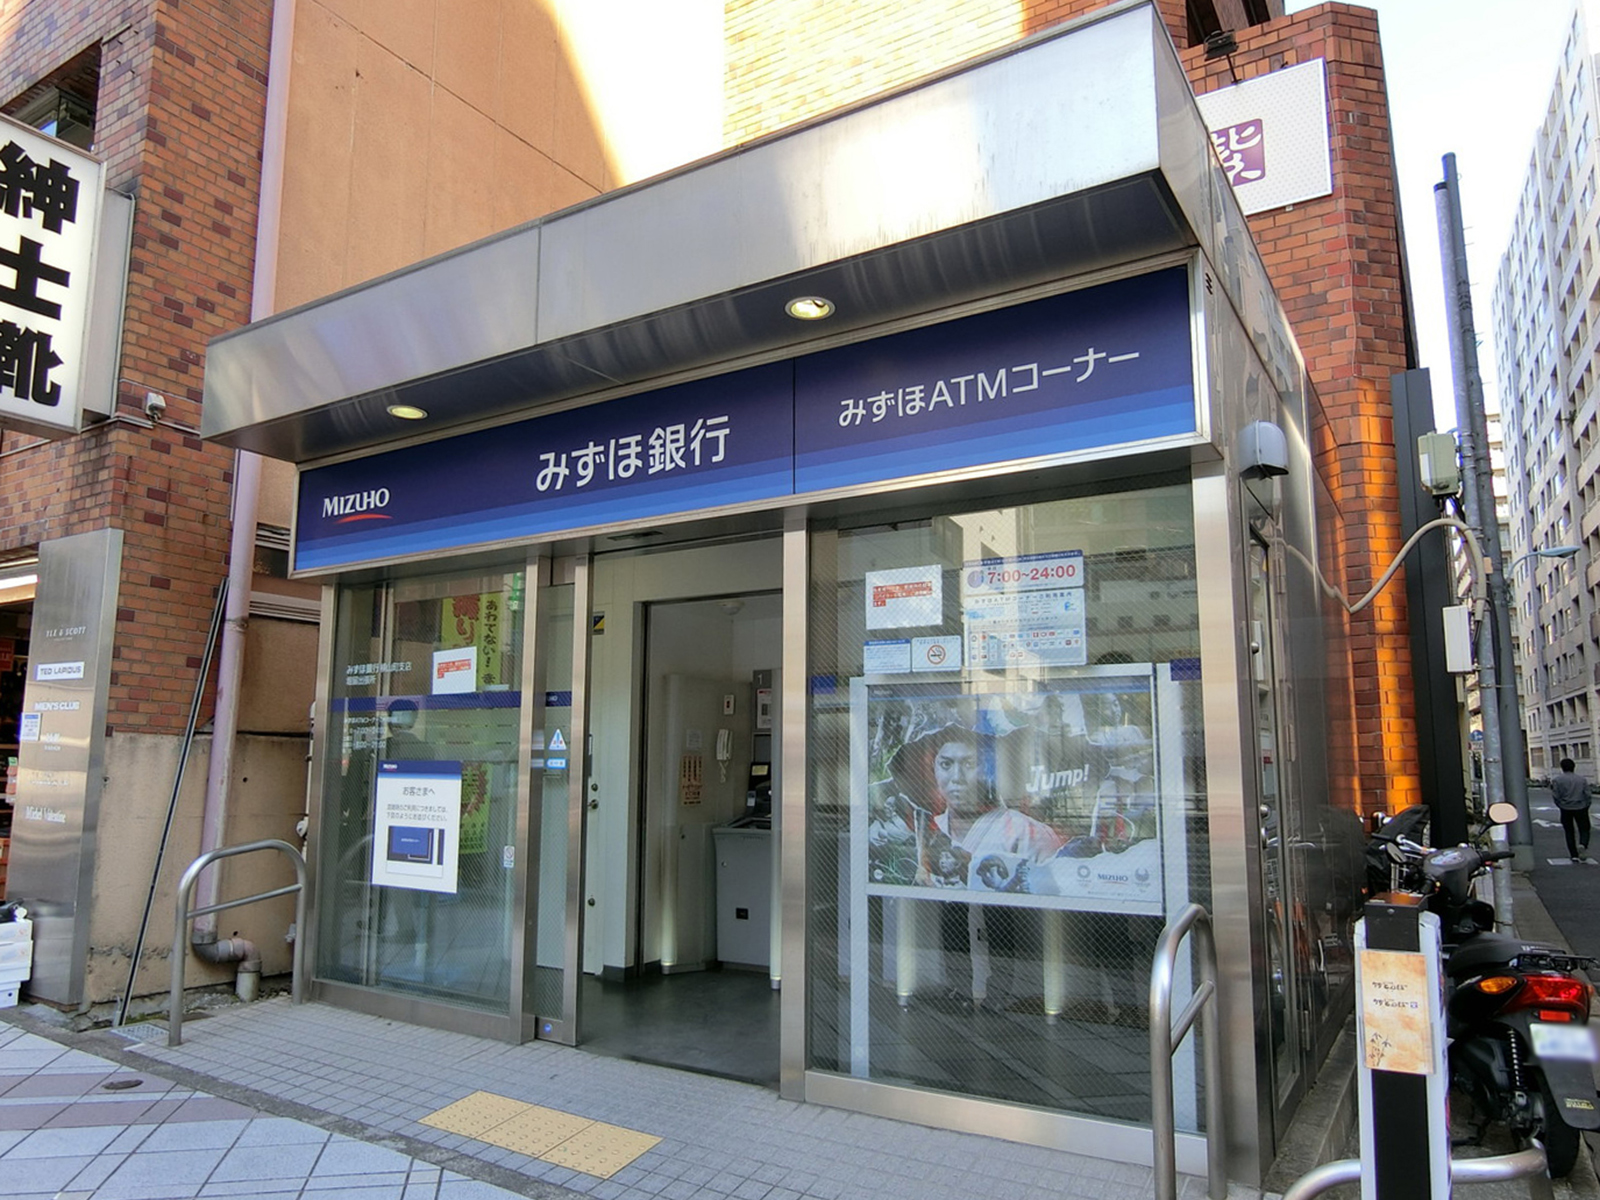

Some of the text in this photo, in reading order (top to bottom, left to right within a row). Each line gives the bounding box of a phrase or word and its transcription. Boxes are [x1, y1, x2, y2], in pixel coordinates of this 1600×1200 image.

[0, 140, 79, 408] 紳士靴
[838, 346, 1141, 428] みずほATMコーナー
[535, 415, 732, 492] みずほ銀行
[322, 486, 391, 519] MIZUHO
[987, 565, 1076, 584] 7:00~24:00
[757, 674, 764, 685] 1
[402, 786, 436, 797] お客さまへ
[1026, 763, 1089, 794] Jump!
[1097, 873, 1129, 882] MIZUHO
